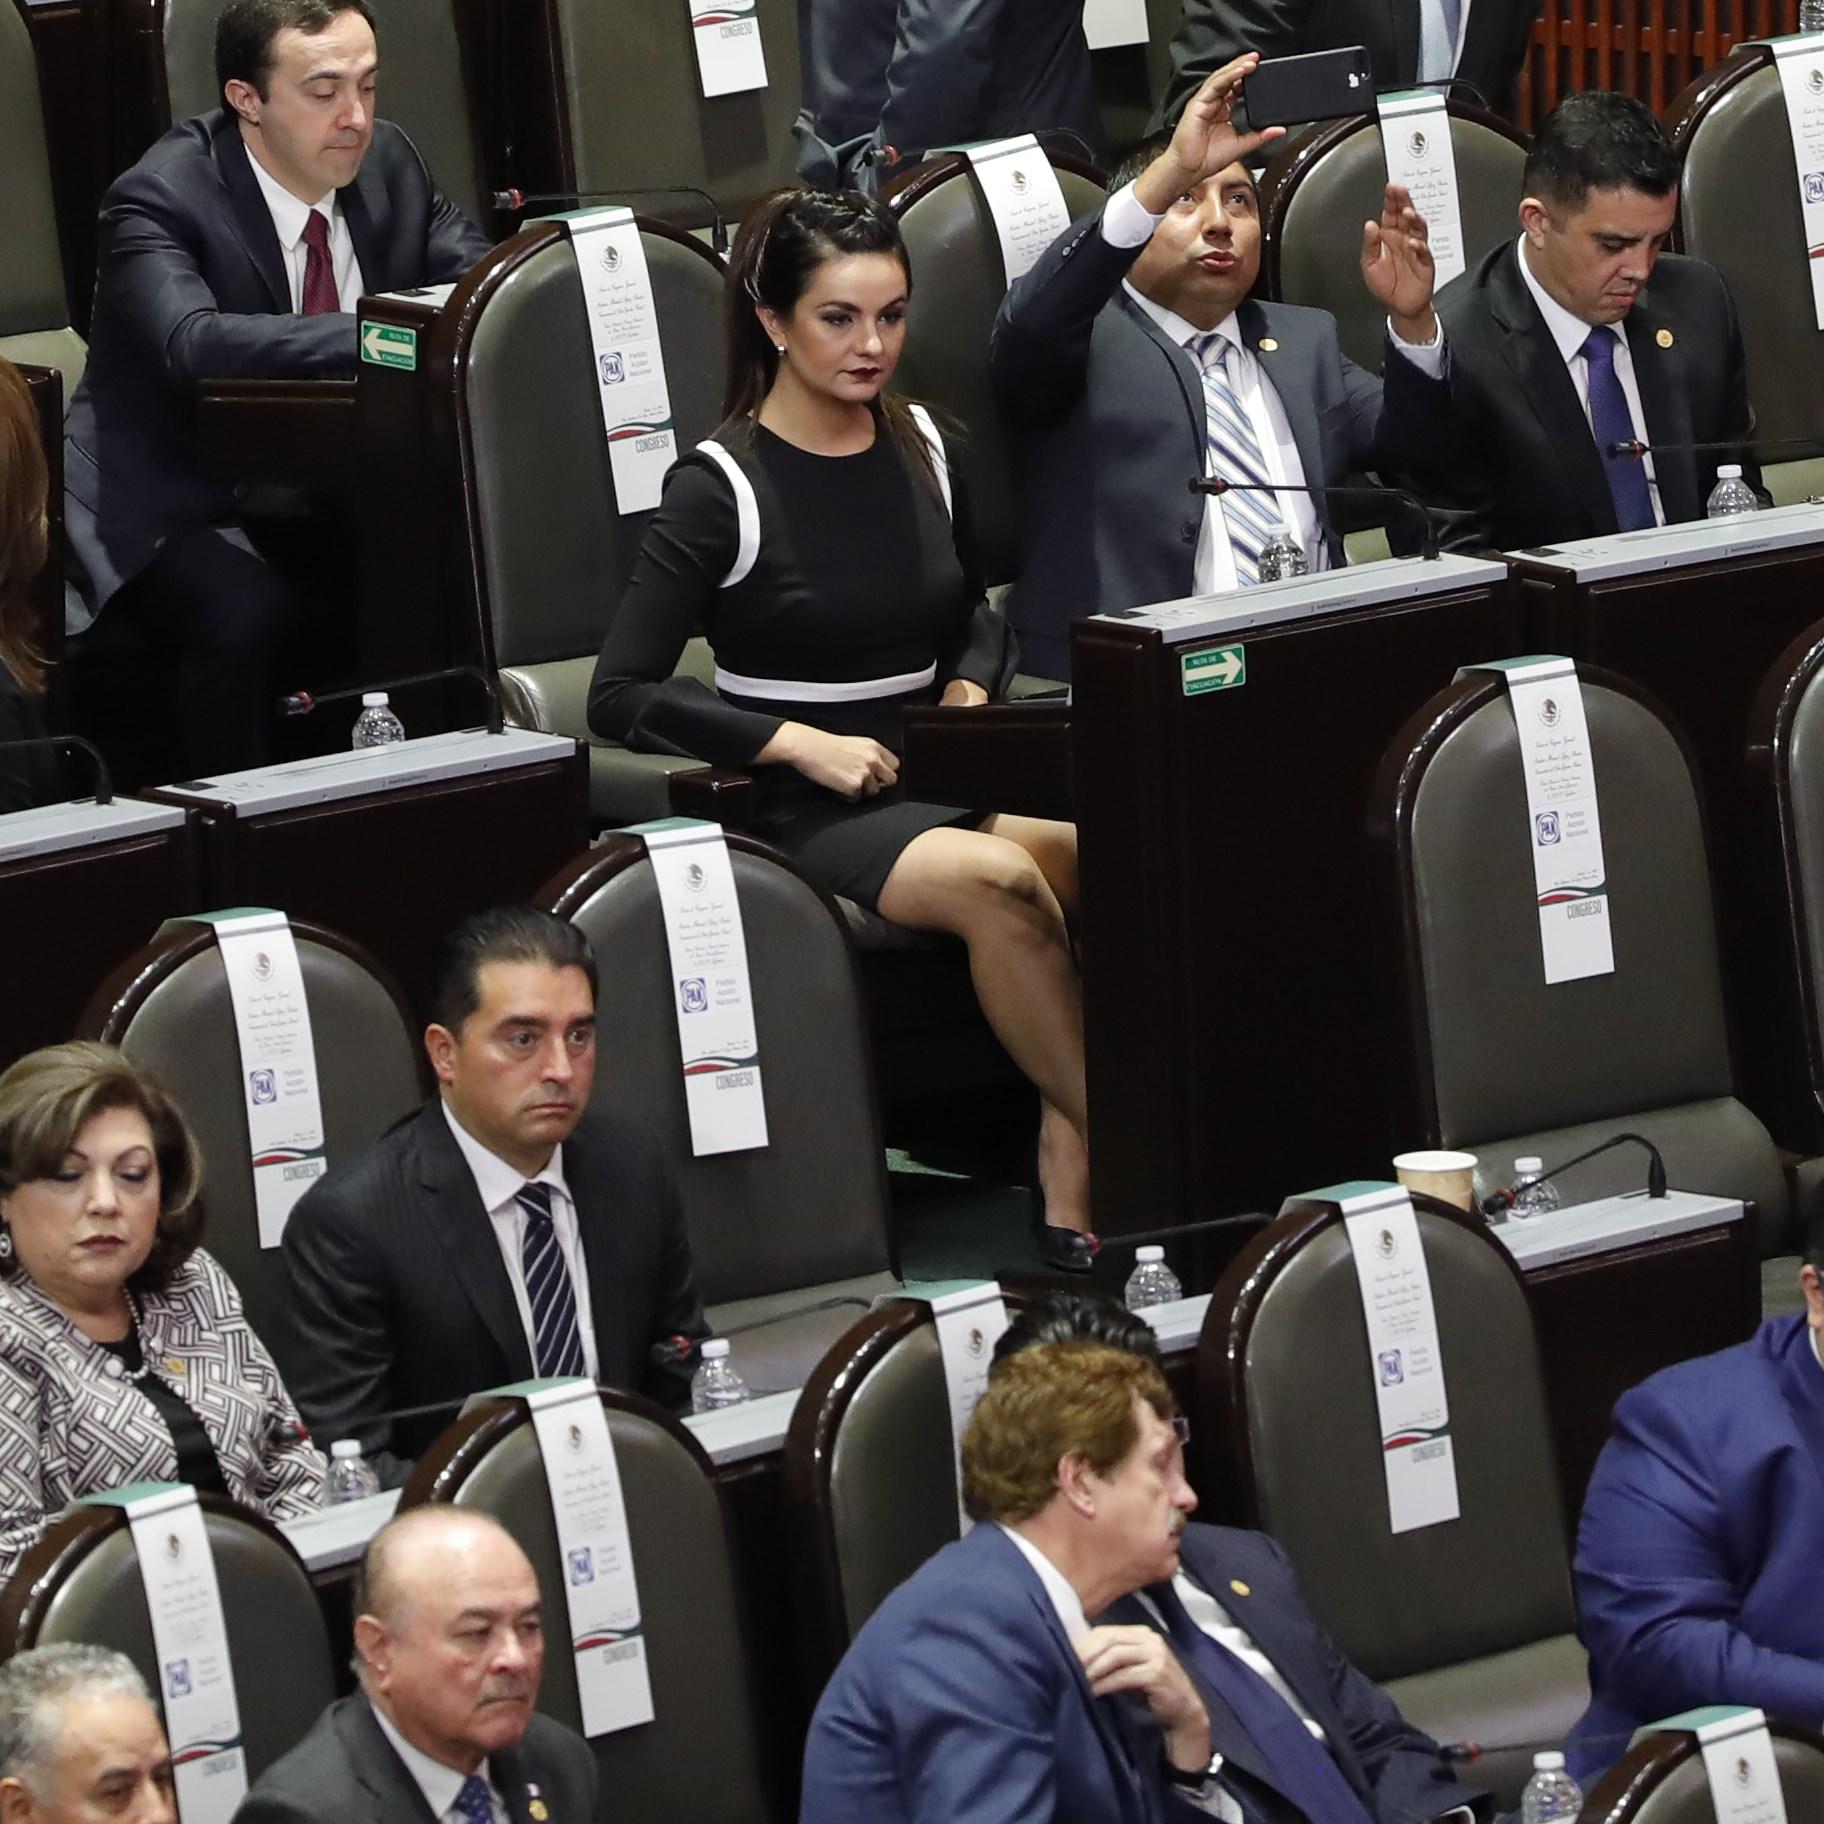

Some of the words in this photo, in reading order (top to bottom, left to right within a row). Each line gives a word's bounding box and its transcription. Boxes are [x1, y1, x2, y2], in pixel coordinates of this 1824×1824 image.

[720, 22, 753, 38] CONGRESO
[1809, 181, 1824, 194] PAN
[606, 362, 620, 376] PAN
[635, 434, 669, 454] CONGRESO
[1542, 822, 1556, 835] PAN
[1566, 899, 1602, 919] CONGRESO
[686, 988, 702, 1002] PAN
[715, 1071, 754, 1090] CONGRESO
